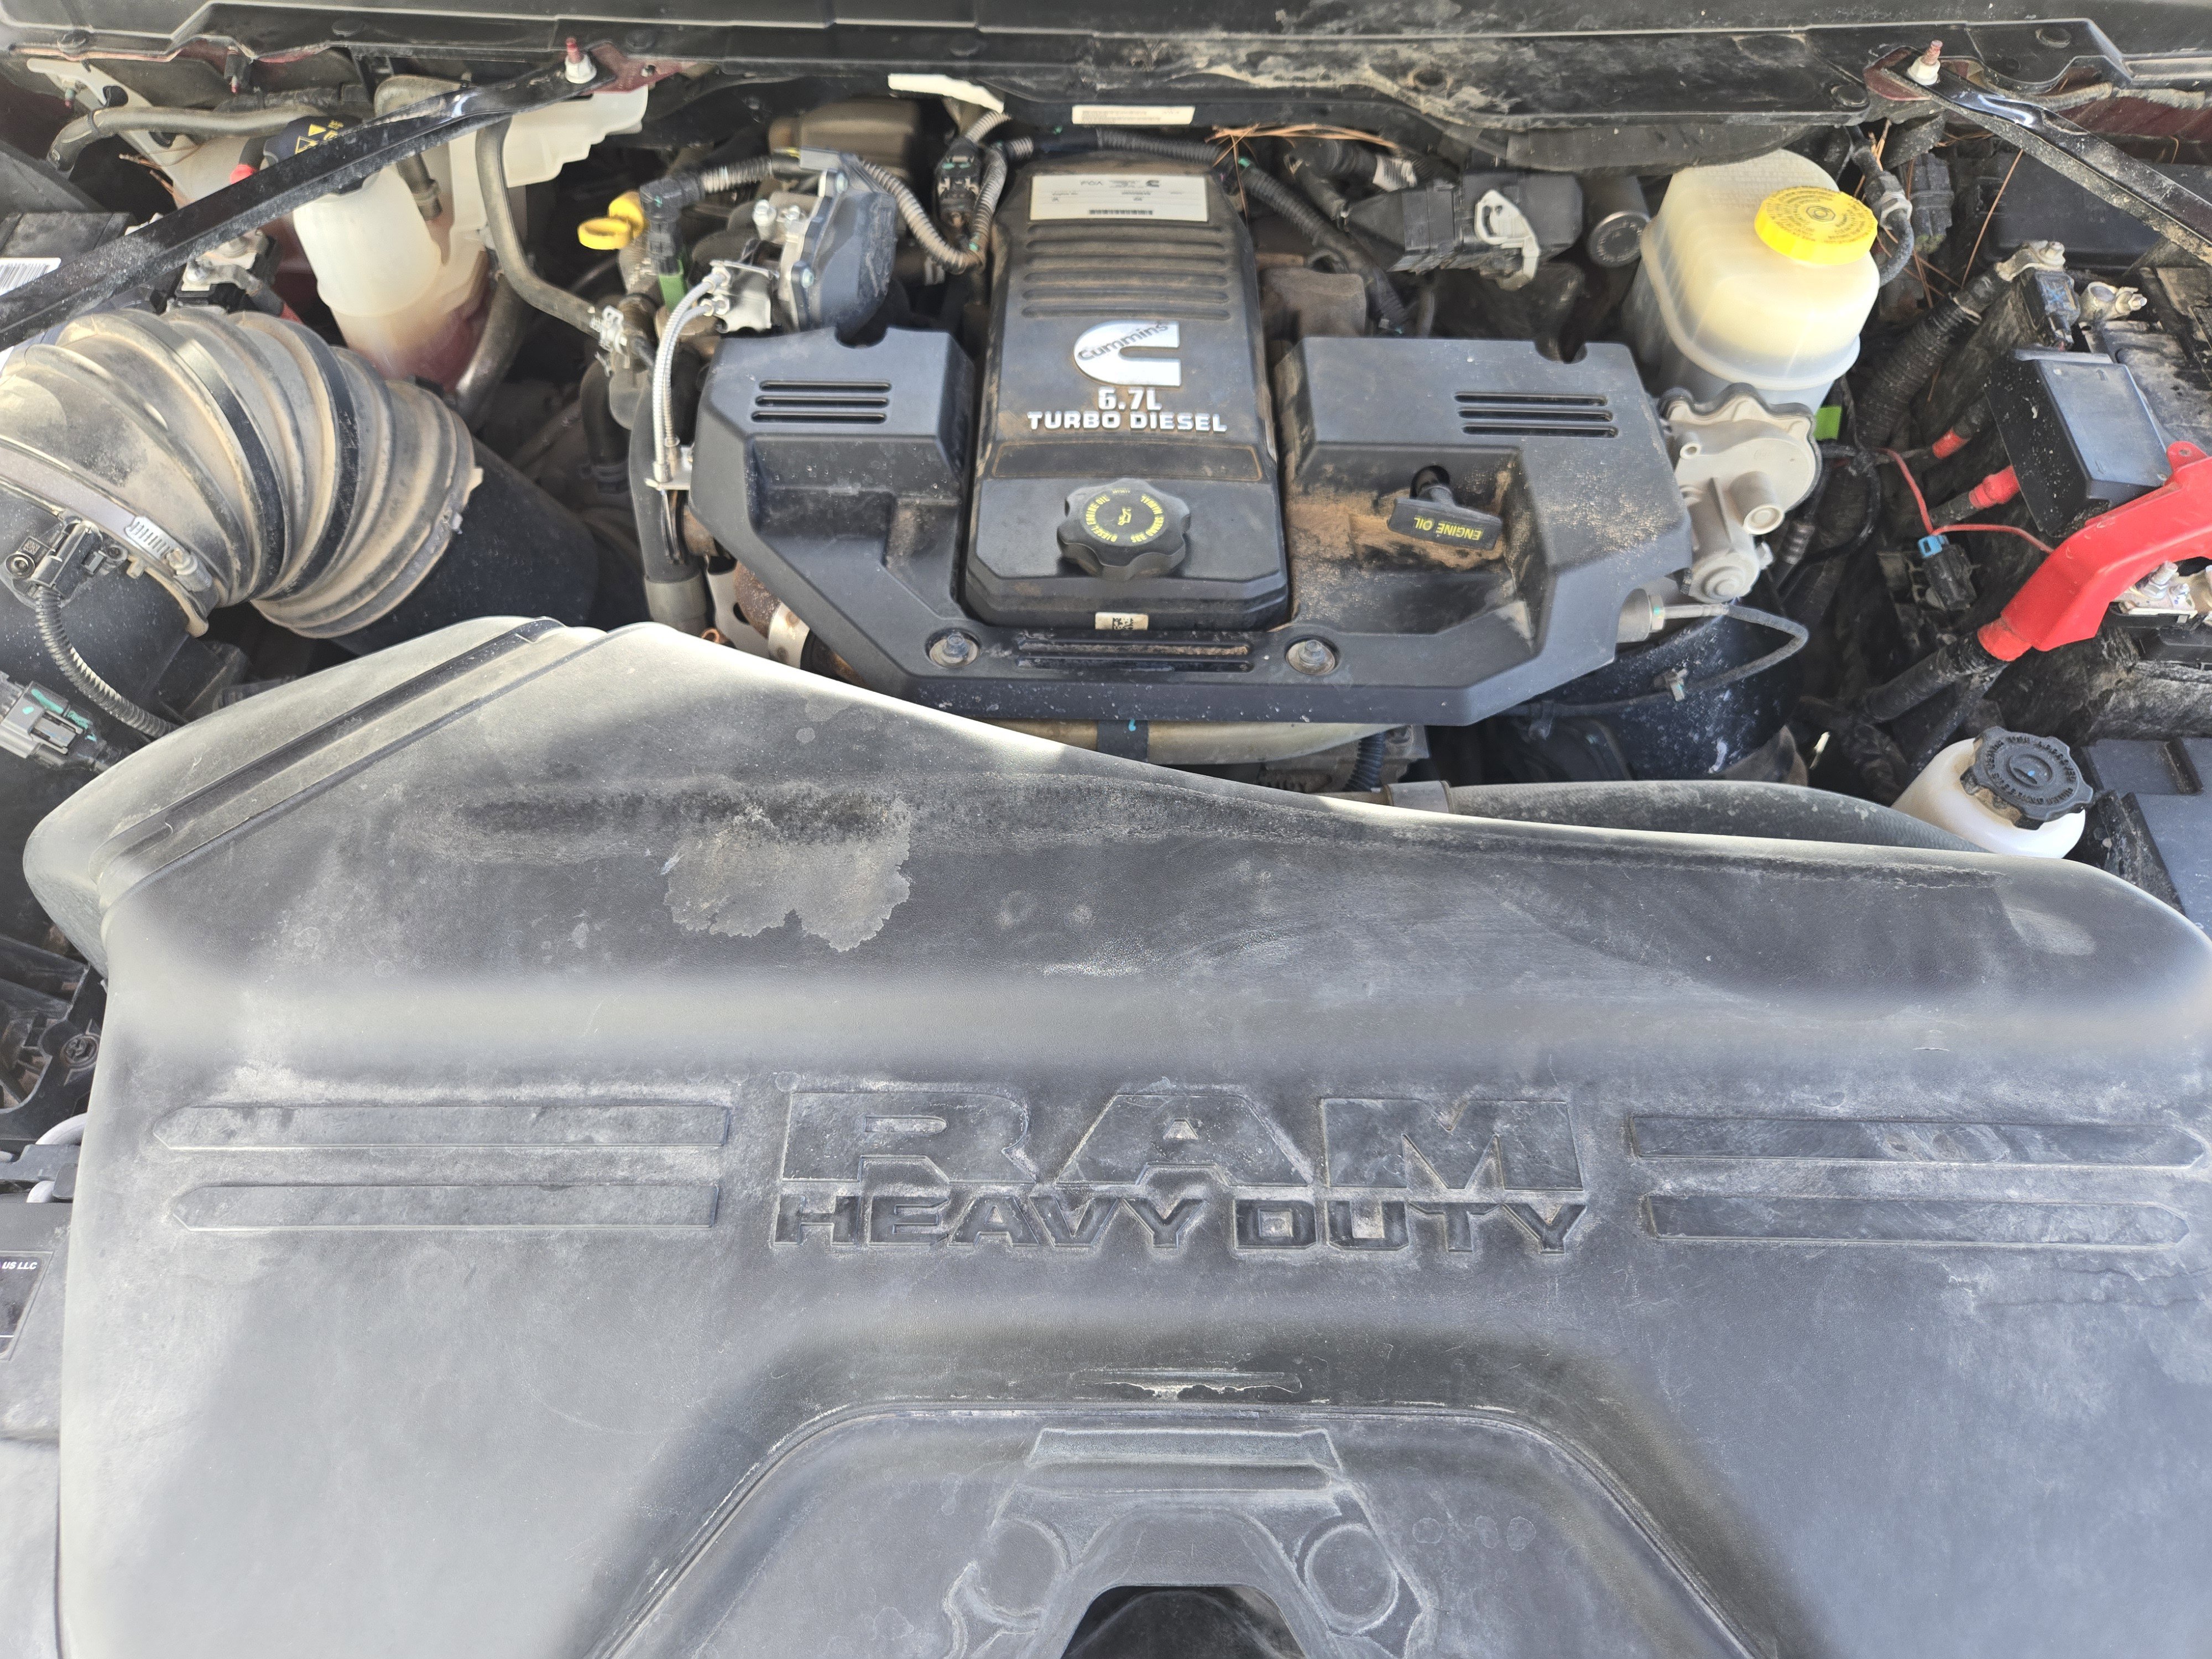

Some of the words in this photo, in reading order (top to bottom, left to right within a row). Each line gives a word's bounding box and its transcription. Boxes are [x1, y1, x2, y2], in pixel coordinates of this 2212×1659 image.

[1078, 322, 1168, 360] Cummins
[1098, 387, 1162, 410] 6.7L
[1027, 411, 1121, 430] TURBO
[1130, 411, 1227, 432] DIESEL
[1095, 496, 1110, 505] OIL
[1086, 503, 1099, 525] ENGINE
[1091, 525, 1118, 542] DIESEL
[1413, 517, 1433, 531] OIL
[1436, 523, 1482, 540] ENGINE
[1130, 533, 1147, 542] SEE
[779, 1088, 1583, 1191] RAM
[772, 1194, 1207, 1249] HEAVY
[1233, 1198, 1587, 1254] DUTY
[17, 1261, 38, 1270] LLC
